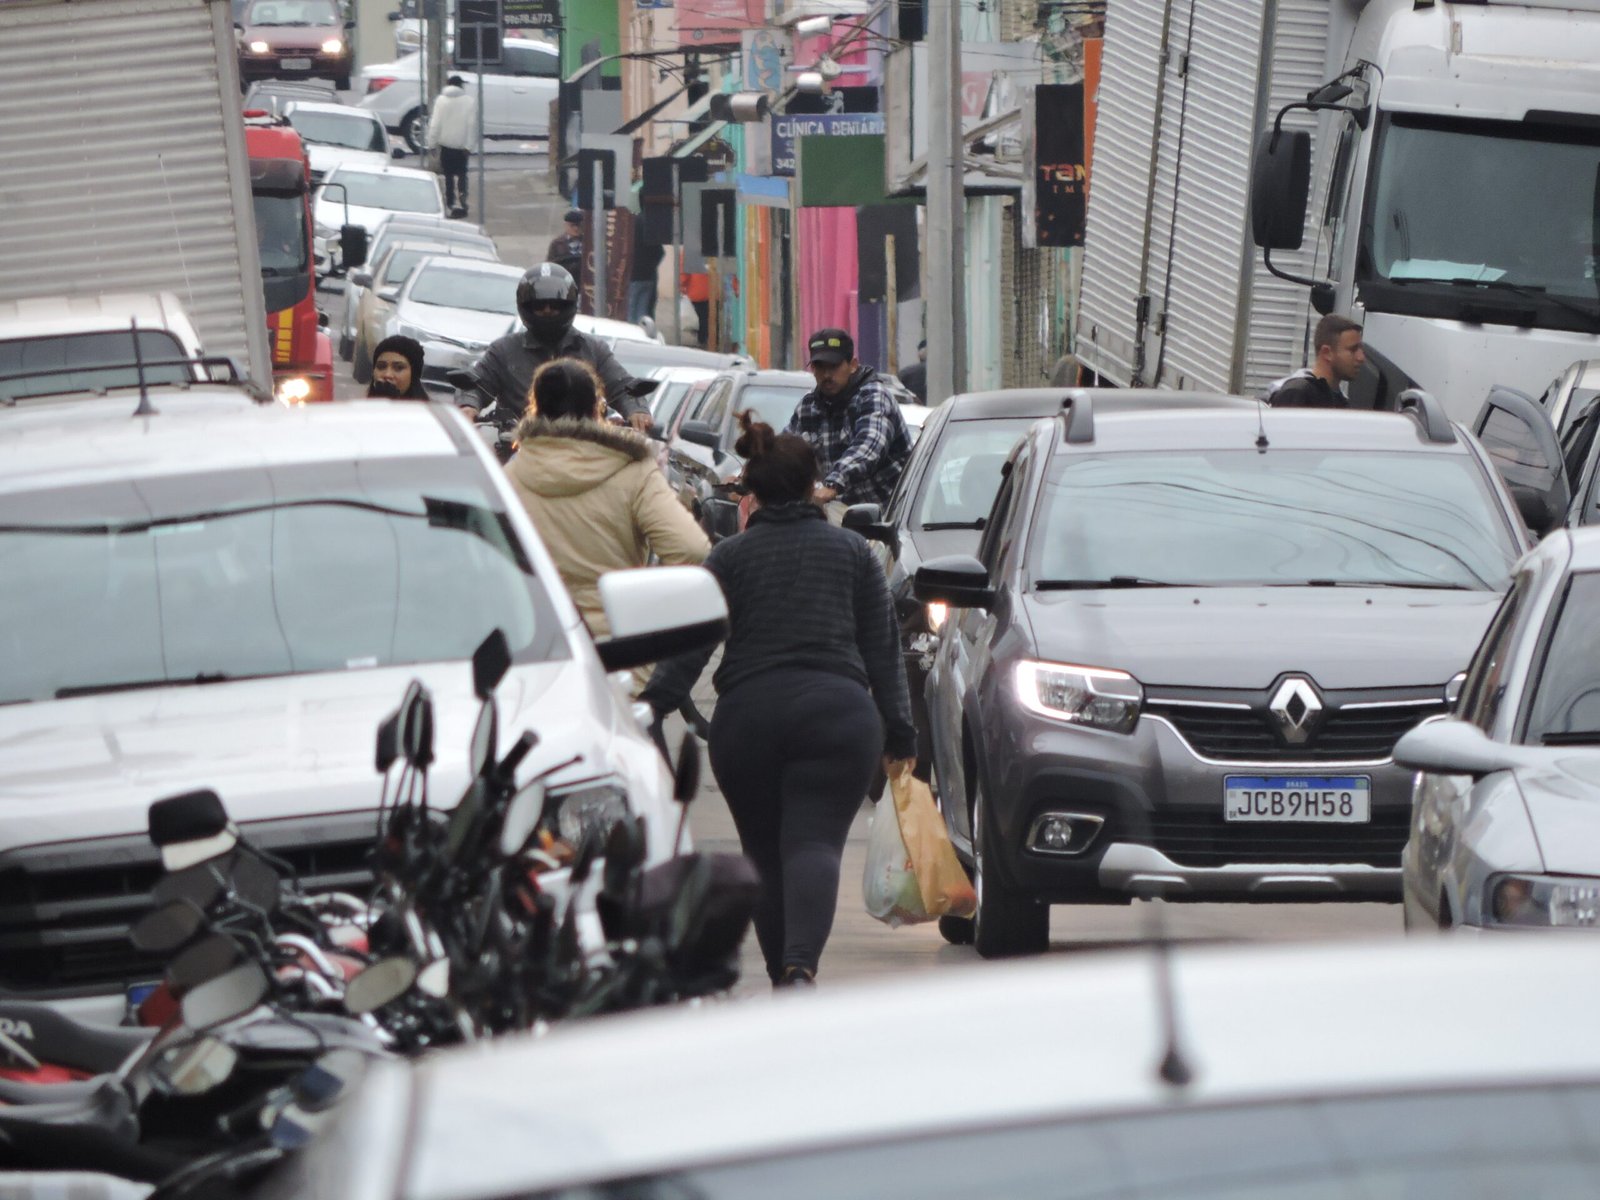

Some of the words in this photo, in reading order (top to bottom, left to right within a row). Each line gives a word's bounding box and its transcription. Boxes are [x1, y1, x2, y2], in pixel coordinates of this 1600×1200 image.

[776, 118, 825, 138] CLÍNICA
[1285, 780, 1309, 788] BRASIL
[1237, 791, 1354, 817] JCB9H58
